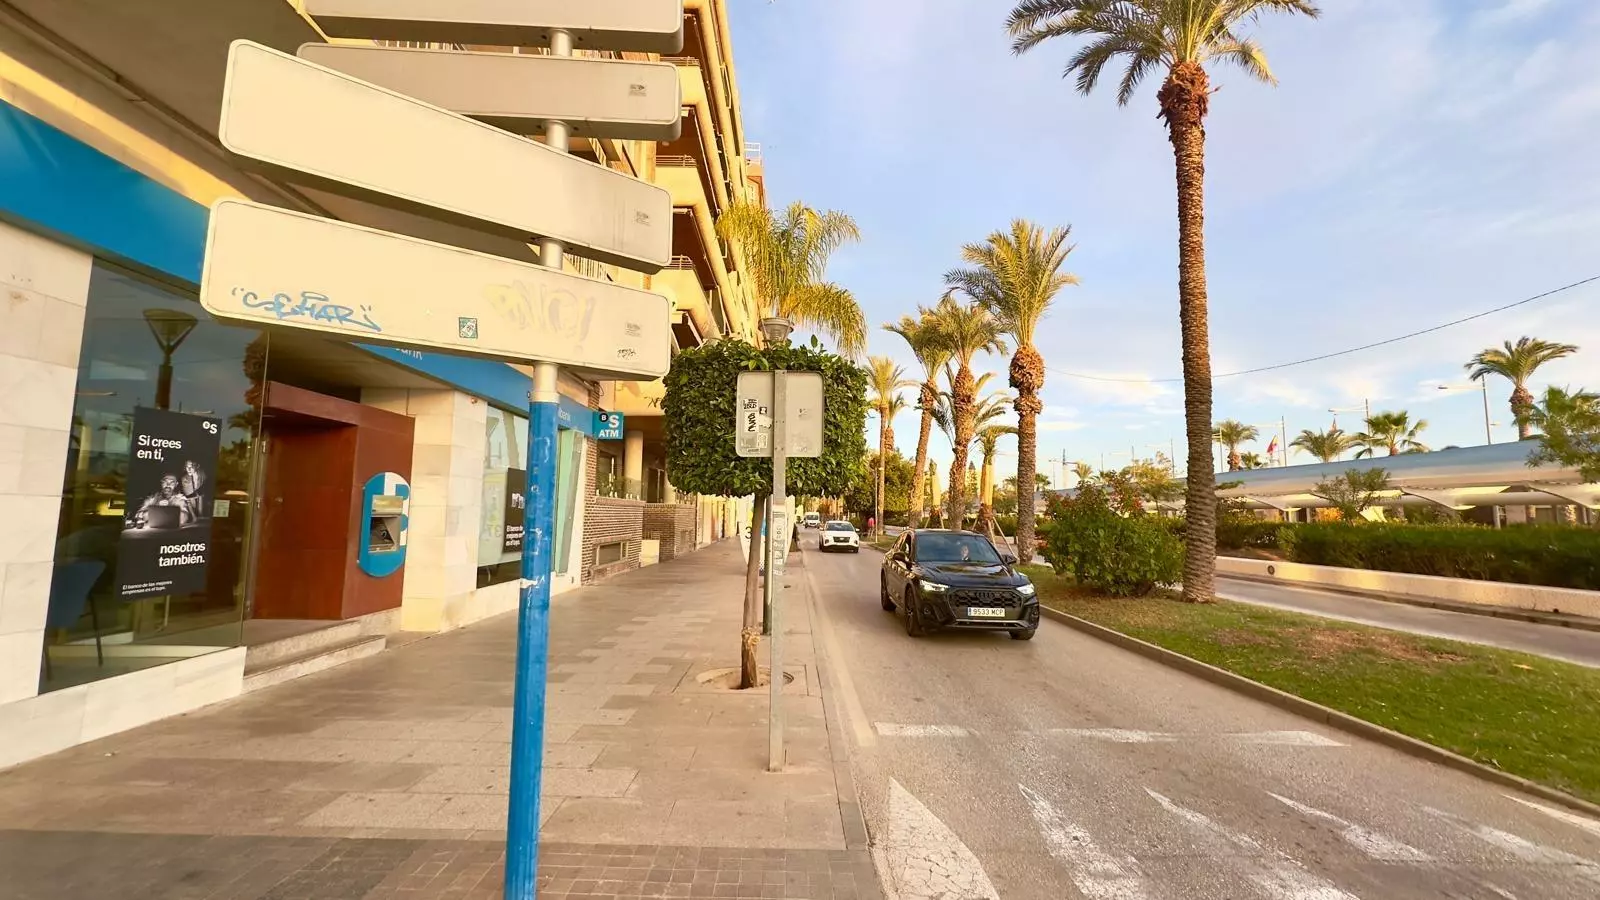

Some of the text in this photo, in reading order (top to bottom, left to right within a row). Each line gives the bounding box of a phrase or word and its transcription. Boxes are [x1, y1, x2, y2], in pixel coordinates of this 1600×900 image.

[598, 429, 619, 438] ATM
[138, 434, 182, 449] Si crees
[136, 448, 164, 462] en ti,
[160, 542, 206, 554] nosotros
[158, 553, 206, 567] también.
[972, 608, 1004, 616] 9533 MCP
